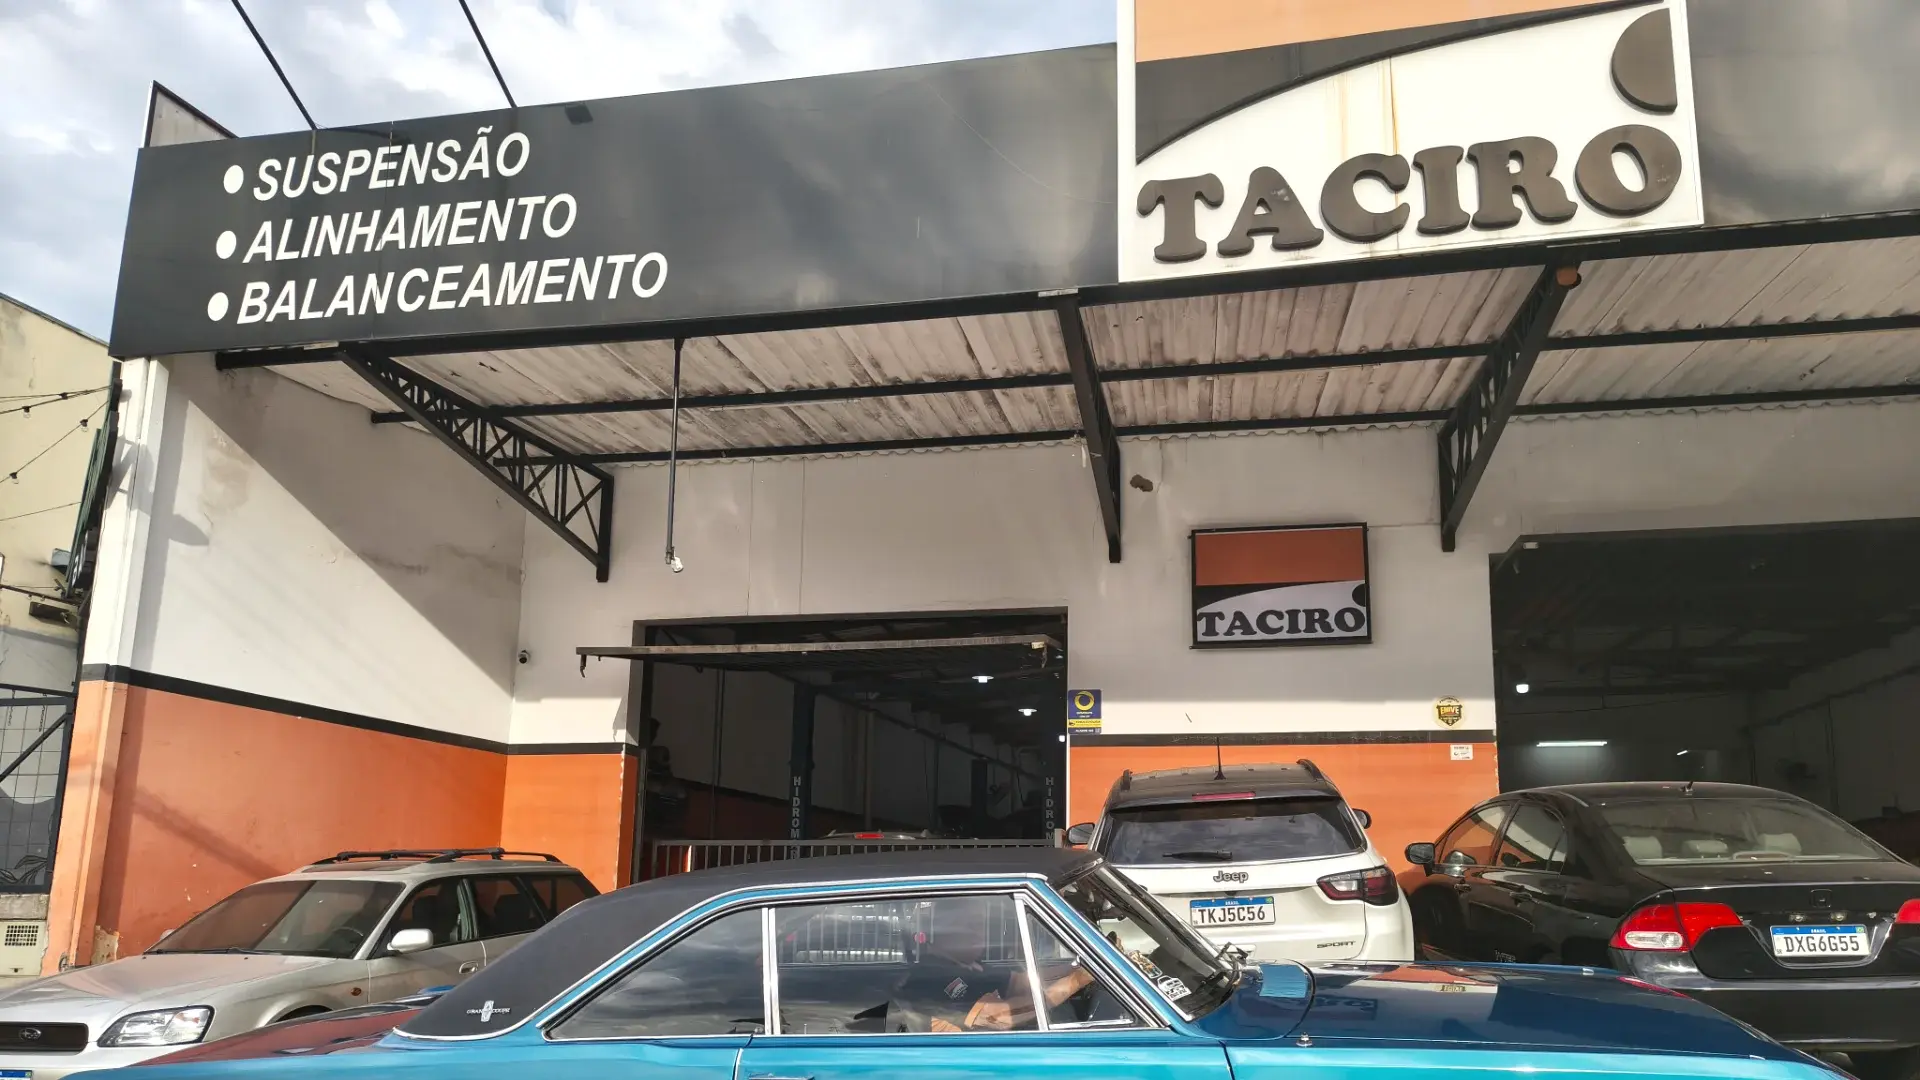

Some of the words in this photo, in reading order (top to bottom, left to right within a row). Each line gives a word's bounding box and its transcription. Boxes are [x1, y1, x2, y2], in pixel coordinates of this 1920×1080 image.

[253, 125, 530, 201] SUSPENSÃO
[1137, 124, 1682, 263] TACIRO
[243, 193, 577, 263] ALINHAMENTO
[236, 252, 668, 325] BALANCEAMENTO
[1197, 607, 1366, 637] TACIRO
[1213, 870, 1249, 883] Jeep
[1198, 906, 1265, 923] TKJ5C56
[1316, 940, 1356, 949] SPORT
[1784, 936, 1859, 952] DXG6G55
